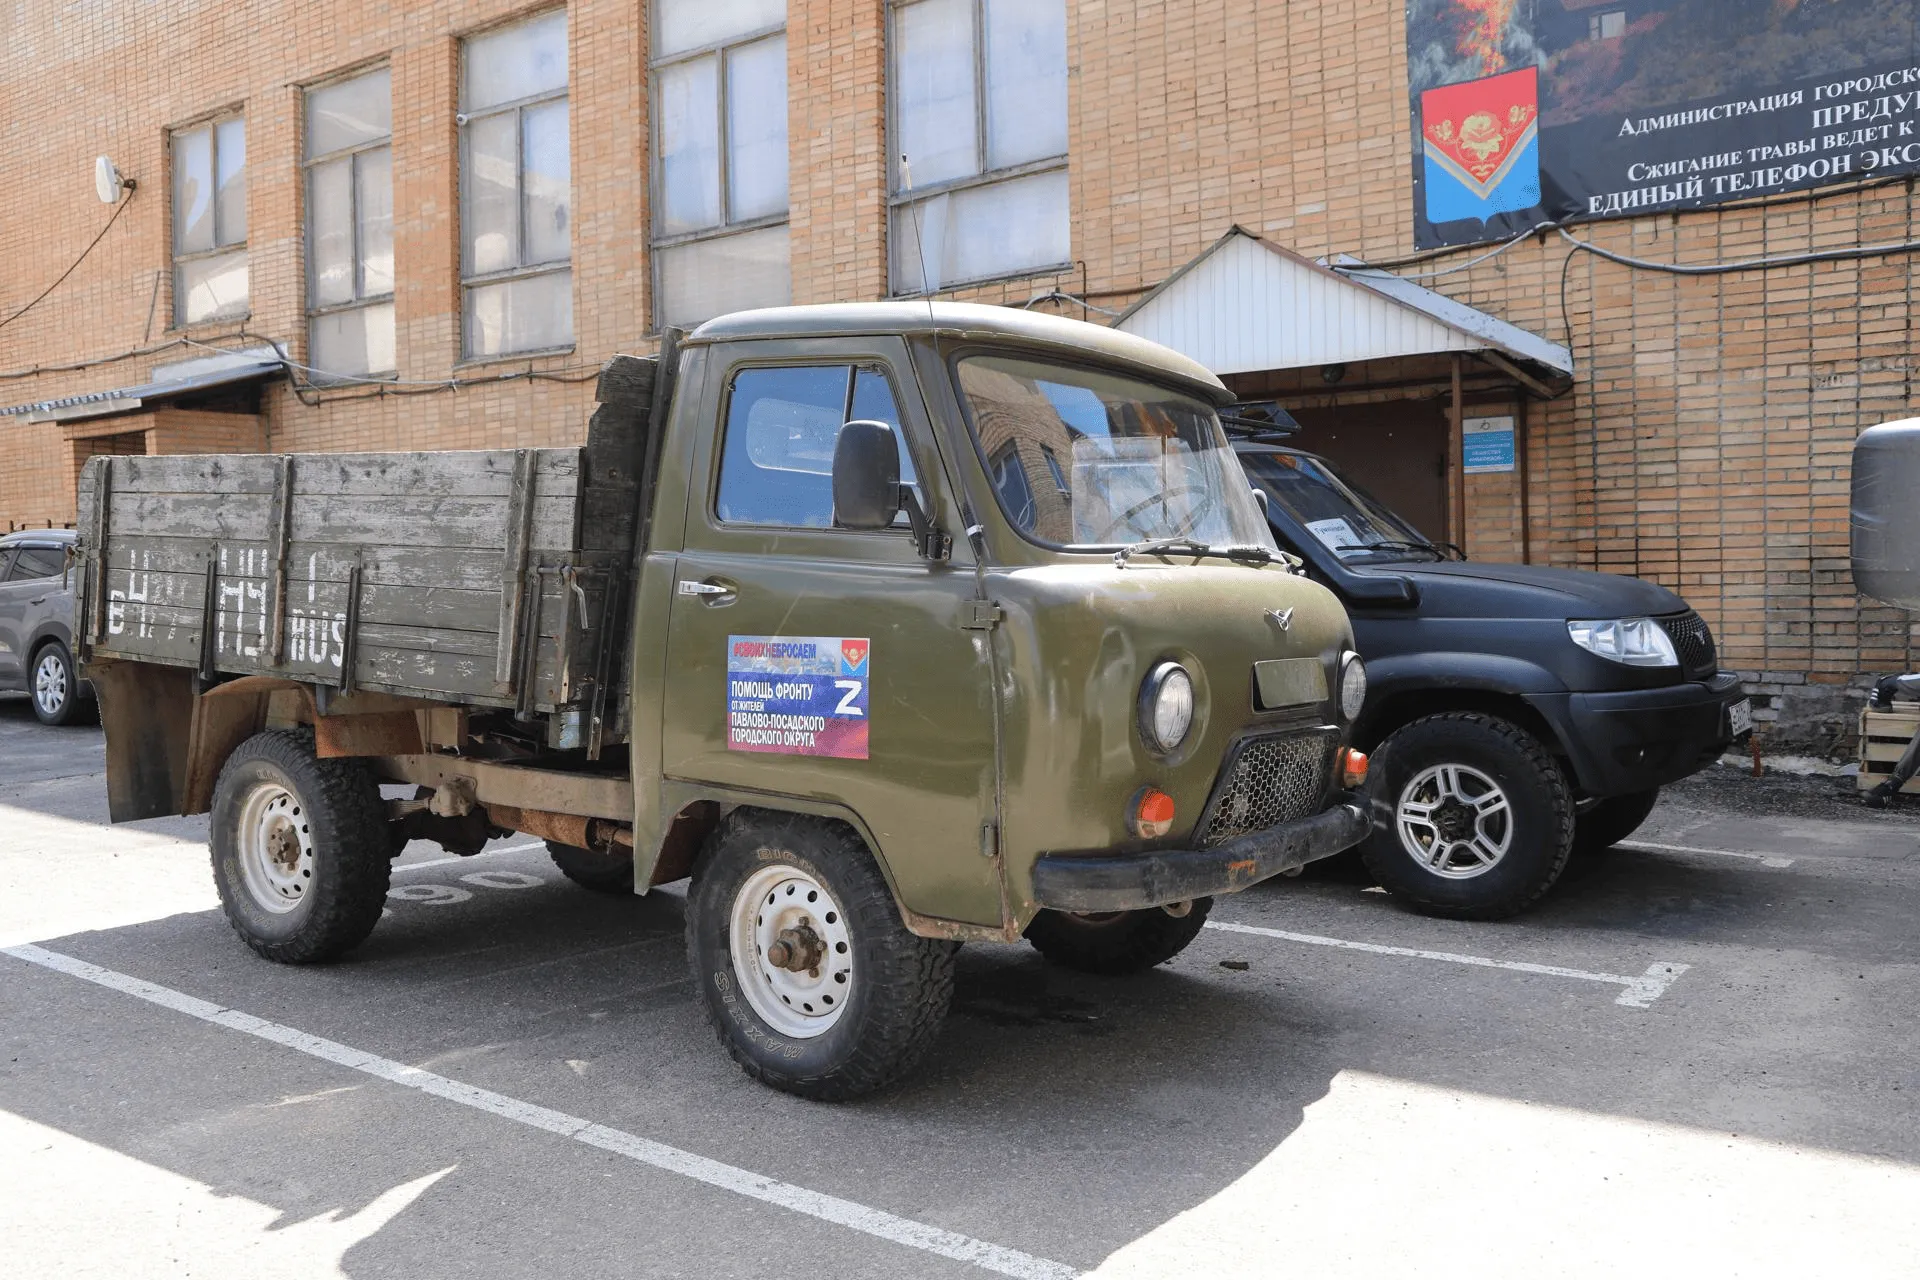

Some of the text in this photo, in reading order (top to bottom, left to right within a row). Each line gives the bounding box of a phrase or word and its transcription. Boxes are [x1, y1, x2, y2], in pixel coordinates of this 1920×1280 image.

[1617, 66, 1920, 137] АДМИНИСТРАЦИЯ ГОРОДСК
[1627, 119, 1915, 182] СЖИГАНИЕ ТРАВЫ ВЕДЕТ К
[1588, 175, 1704, 216] ЕДИНЫЙ
[1710, 153, 1852, 194] ТЕЛЕФОН
[731, 680, 814, 701] ПОМОЩЬ ФРОНТУ
[731, 699, 765, 712] ОТ ЖИТЕЛЕЙ
[834, 679, 864, 716] Z
[731, 711, 825, 732] ПАВЛОВО-ПОСАДСКОГО
[731, 727, 816, 748] ГОРОДСКОГО ОКРУГА
[713, 970, 805, 1059] MAXXIS
